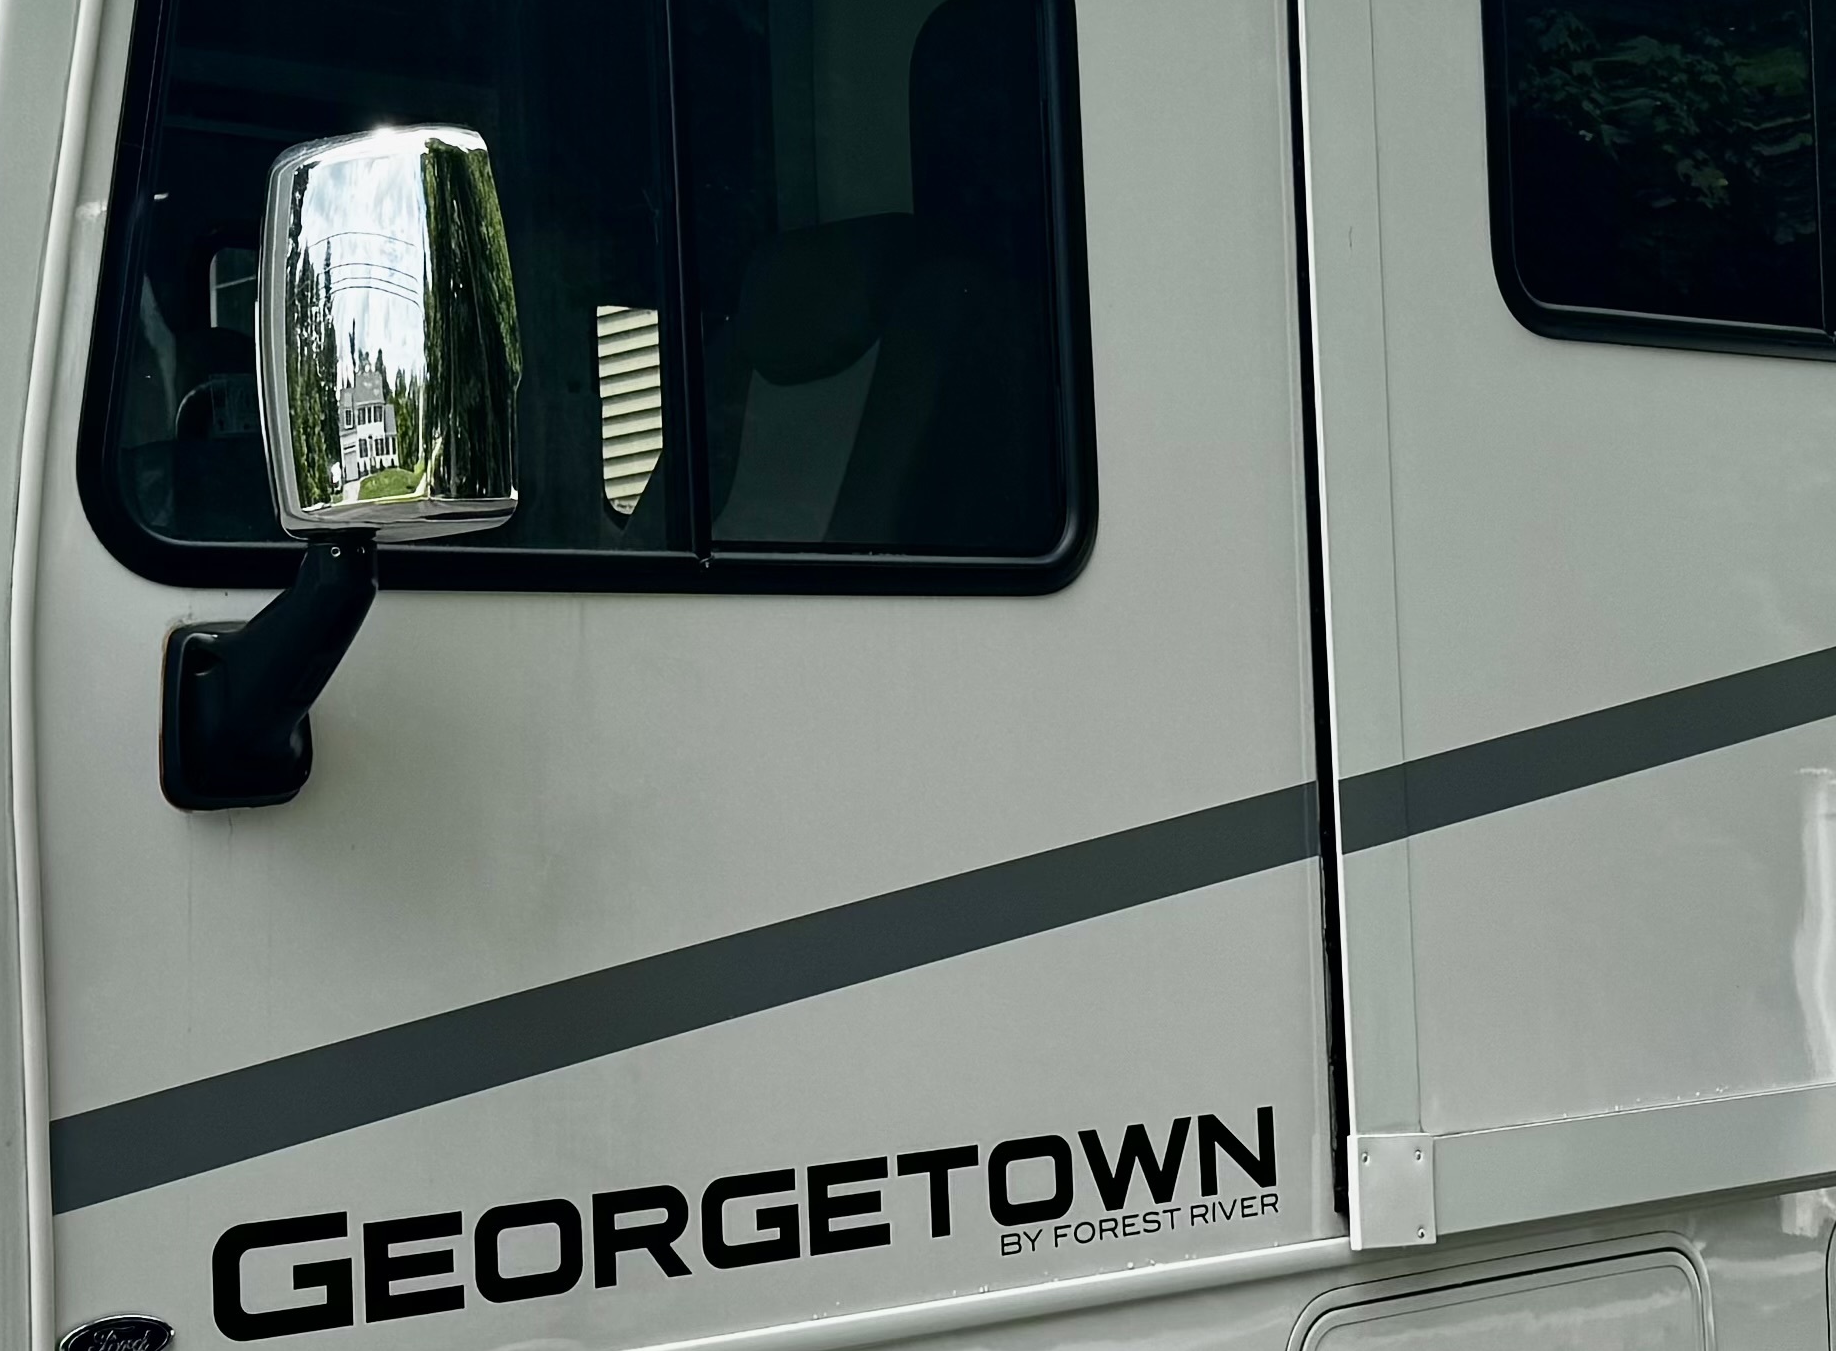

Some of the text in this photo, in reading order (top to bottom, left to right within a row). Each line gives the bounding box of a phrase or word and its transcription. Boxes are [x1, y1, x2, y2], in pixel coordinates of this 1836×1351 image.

[211, 1106, 1277, 1342] GEORGETOWN
[1000, 1192, 1280, 1257] BY FOREST RIVER
